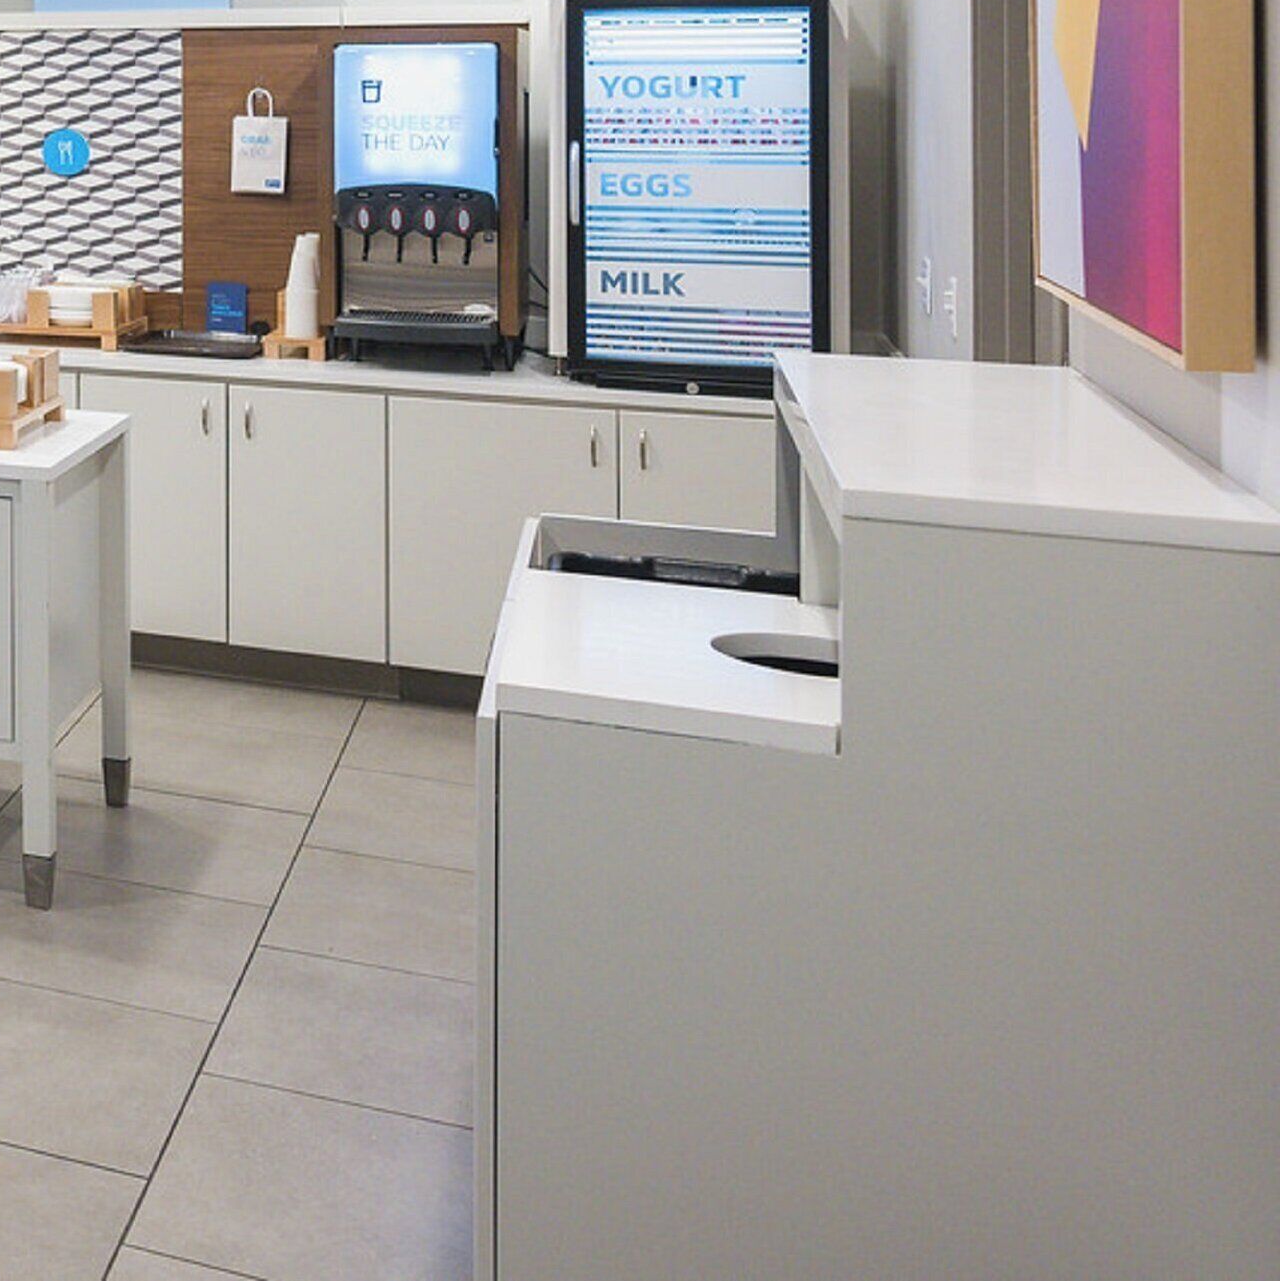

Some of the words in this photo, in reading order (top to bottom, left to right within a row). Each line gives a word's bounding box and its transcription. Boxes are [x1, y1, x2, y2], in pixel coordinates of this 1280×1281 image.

[598, 74, 746, 99] YOGURT
[362, 114, 462, 131] SQUEEZE
[362, 133, 400, 151] THE
[409, 133, 451, 152] DAY
[600, 173, 693, 197] EGGS
[600, 270, 686, 297] MILK
